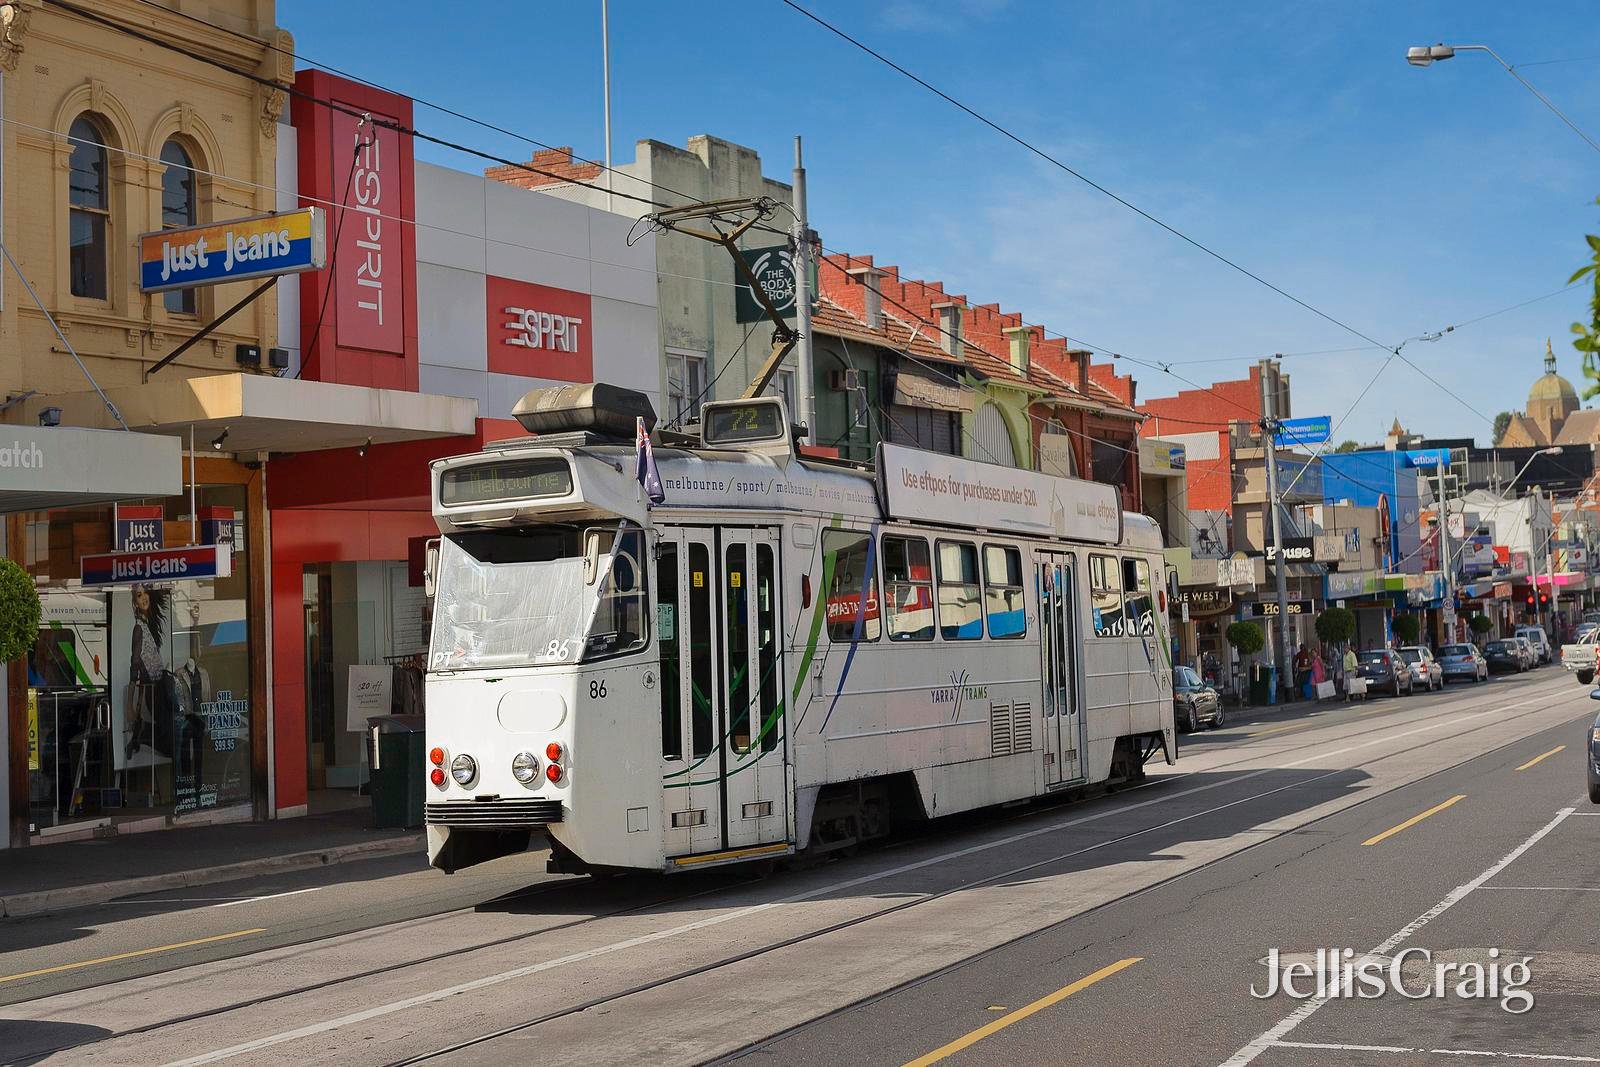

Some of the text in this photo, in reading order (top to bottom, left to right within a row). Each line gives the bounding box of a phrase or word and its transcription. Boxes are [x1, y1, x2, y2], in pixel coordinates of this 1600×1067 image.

[355, 133, 382, 325] ESPRIT
[161, 229, 291, 281] Just Jeans
[766, 269, 784, 279] THE
[505, 307, 582, 352] ESPRIT
[732, 408, 758, 431] 72
[666, 477, 724, 491] melbourne
[736, 482, 765, 494] sport
[901, 467, 918, 489] Use
[920, 470, 947, 496] eftpos
[948, 474, 961, 495] for
[962, 480, 1001, 501] purchases
[1002, 485, 1022, 504] under
[129, 521, 155, 540] Just
[218, 520, 231, 540] Just
[112, 556, 188, 580] Just Jeans
[1192, 591, 1219, 601] WEST
[1263, 603, 1301, 615] Hose
[547, 640, 569, 661] 86
[217, 691, 231, 700] SHE
[590, 680, 607, 699] 86
[931, 686, 988, 704] YARRA TRAMS
[208, 712, 240, 730] PANTS
